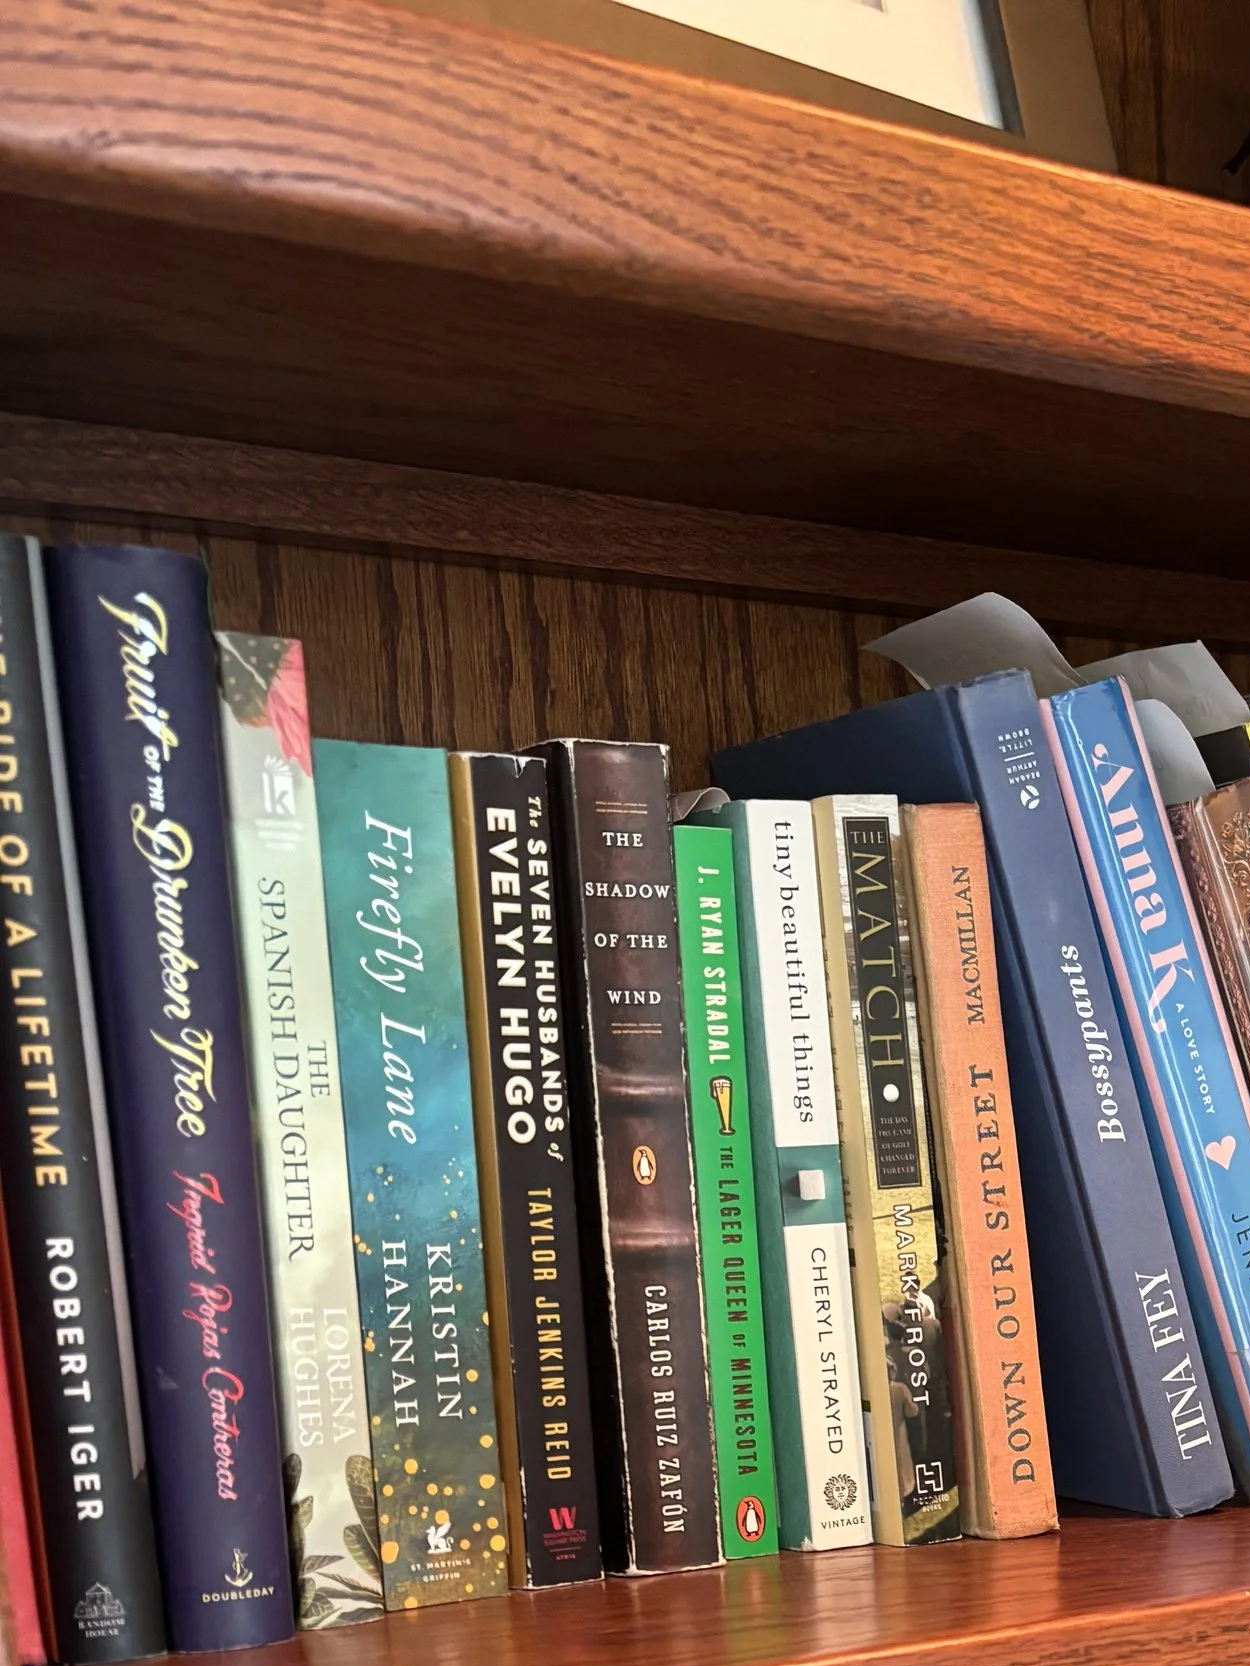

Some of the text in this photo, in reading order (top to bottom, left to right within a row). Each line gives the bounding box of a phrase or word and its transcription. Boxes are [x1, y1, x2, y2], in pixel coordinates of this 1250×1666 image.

[585, 882, 670, 898] SHADOW
[602, 832, 643, 848] THE
[850, 831, 886, 845] THE
[357, 810, 428, 1145] Firefly Lane
[486, 806, 537, 1145] EVELYN HUGO
[594, 934, 668, 949] OF THE
[607, 990, 661, 1005] WIND
[697, 866, 730, 1066] J. RYAN STRADAL
[773, 820, 814, 1123] tiny beautiful things
[850, 850, 904, 1068] MATCH
[951, 866, 986, 1025] MACMILLAN
[258, 877, 316, 1261] SPANISH DAUGHTER
[307, 1040, 331, 1098] THE
[1061, 944, 1127, 1142] Bossypants
[1175, 1003, 1216, 1115] A LOVE STORY
[382, 1240, 420, 1428] HANNAH
[426, 1243, 463, 1420] KRISTIN
[527, 1187, 573, 1481] TAYLOR JENKINS REID
[719, 1146, 758, 1477] THE LAGER QUEEN OF MINNESOTA
[811, 1247, 844, 1455] CHERYL STRAYED
[892, 1204, 930, 1407] MARK FROST
[970, 1064, 1036, 1485] DOWN OUR STREET
[1135, 1268, 1212, 1461] TINA FEY
[46, 1237, 103, 1522] ROBERT IGER
[288, 1307, 324, 1448] HUGHES
[323, 1307, 356, 1444] LORENA
[644, 1284, 685, 1535] CARLOS RUIZ ZAFÓN
[202, 1586, 275, 1603] DOUBLEDAY
[821, 1516, 865, 1530] VINTAGE
